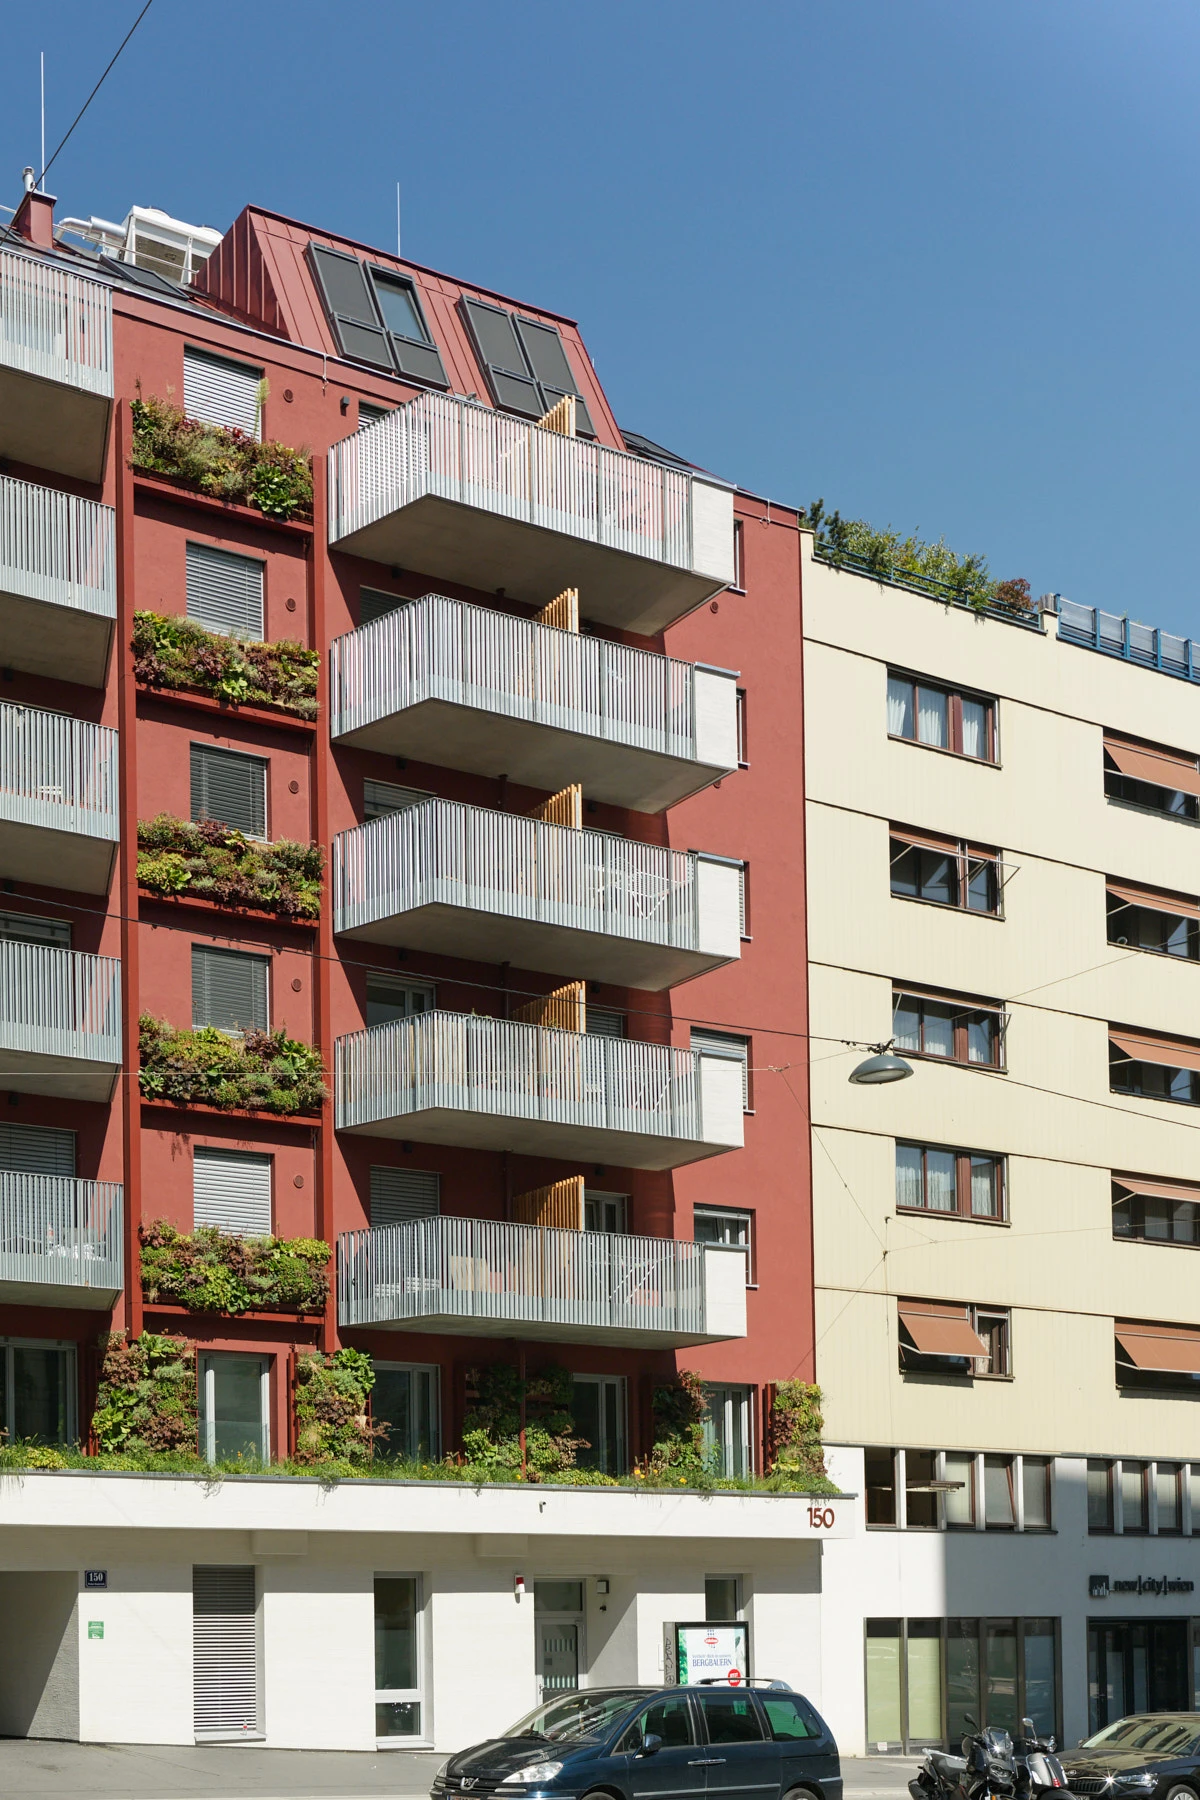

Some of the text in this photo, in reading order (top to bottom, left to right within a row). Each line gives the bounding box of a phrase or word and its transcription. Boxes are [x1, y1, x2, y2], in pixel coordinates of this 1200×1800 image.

[806, 1507, 835, 1528] 150
[89, 1572, 103, 1582] 150
[692, 1658, 732, 1667] BERGBAUERN
